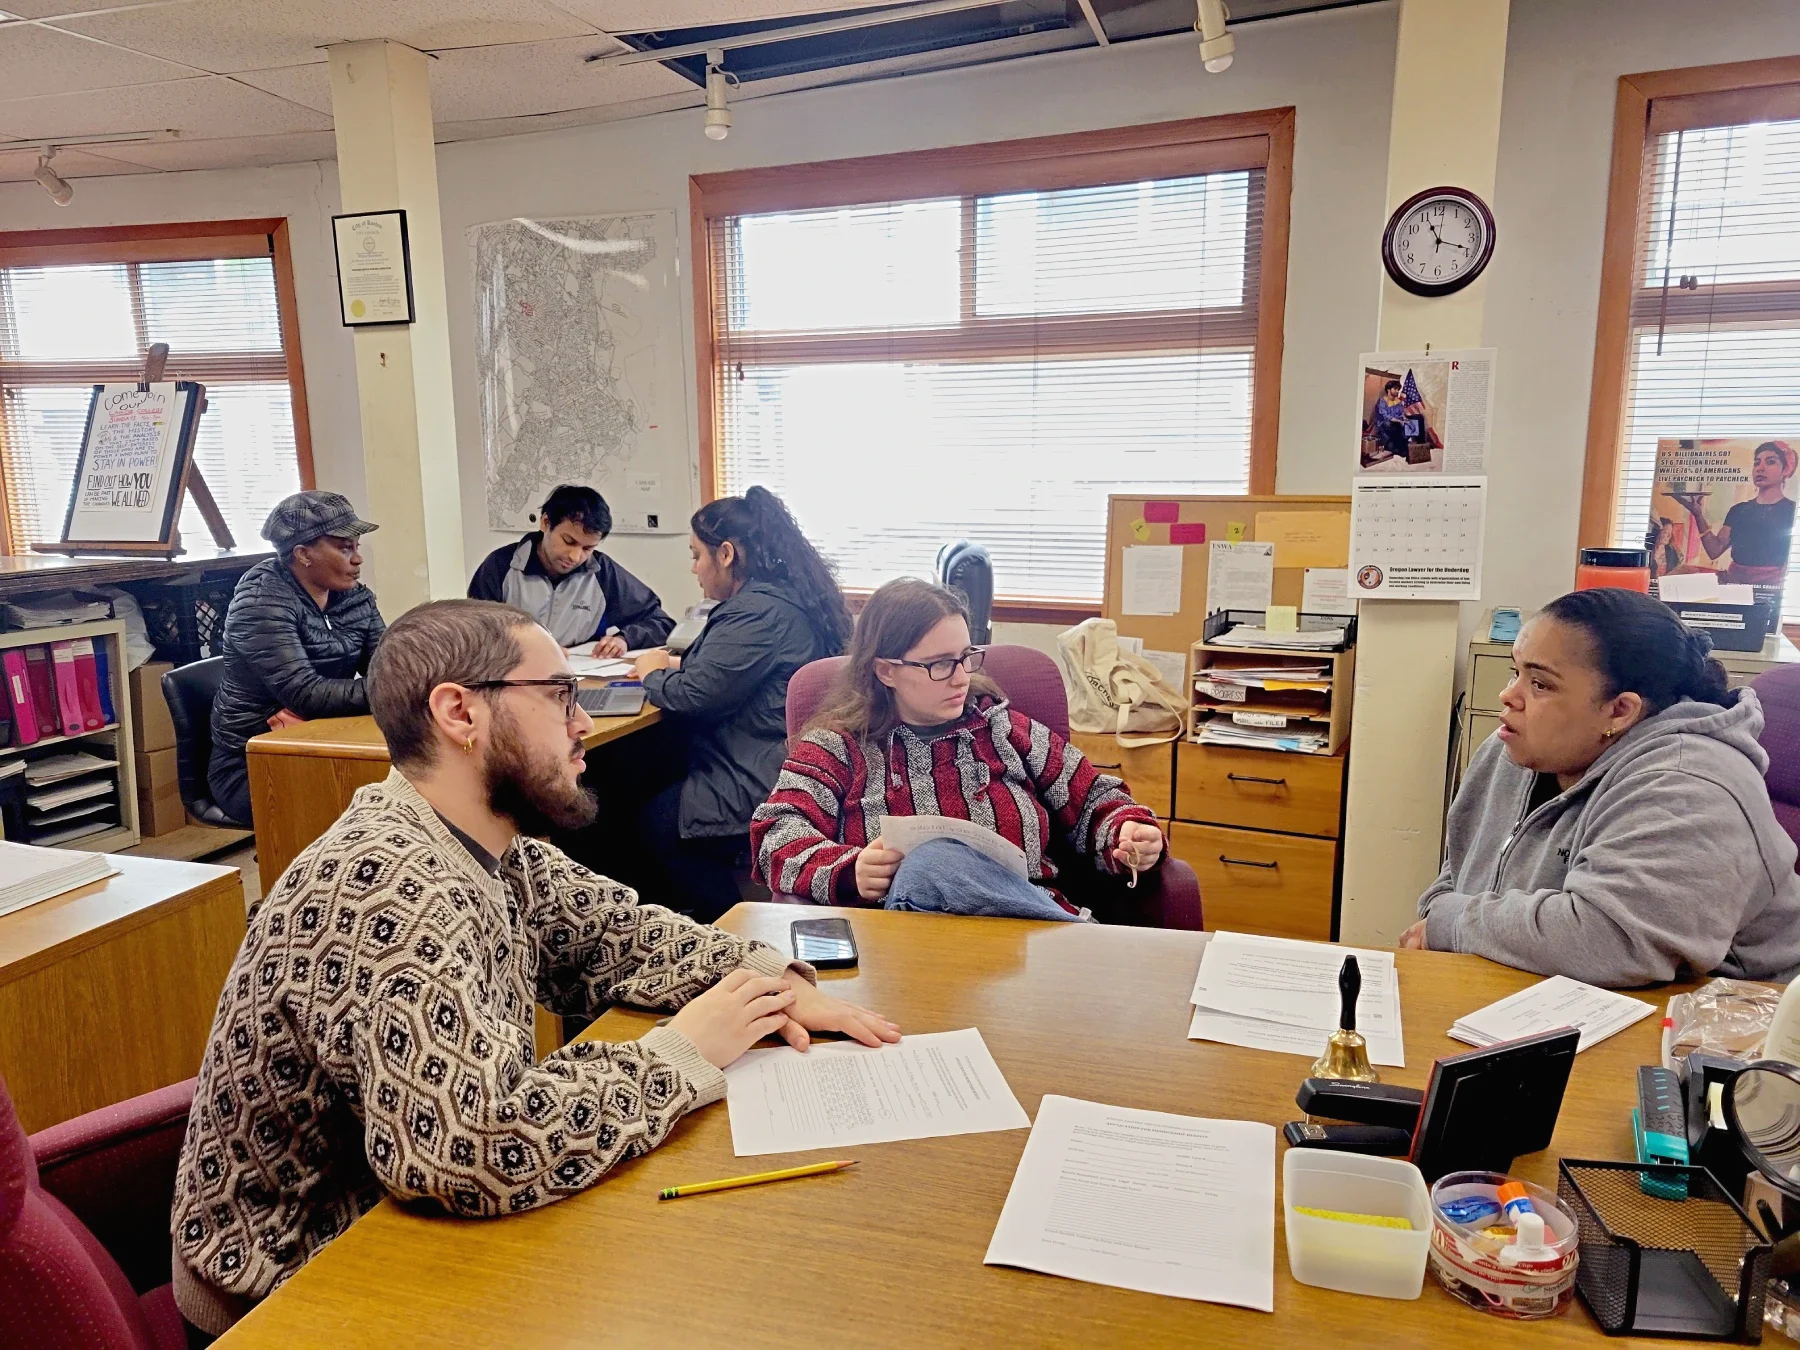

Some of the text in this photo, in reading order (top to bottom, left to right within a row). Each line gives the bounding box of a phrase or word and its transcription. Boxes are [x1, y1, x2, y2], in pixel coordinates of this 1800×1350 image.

[1434, 206, 1446, 216] 12
[1455, 209, 1458, 218] 1
[1421, 212, 1429, 222] 11
[1464, 218, 1471, 228] 2
[1409, 224, 1419, 235] 10
[1468, 233, 1475, 243] 3
[1403, 240, 1409, 250] 9
[1464, 248, 1470, 257] 4
[1407, 253, 1414, 264] 8
[1420, 263, 1426, 273] 7
[1451, 260, 1458, 270] 5
[1434, 266, 1441, 276] 6
[1452, 361, 1459, 370] R
[105, 391, 139, 410] Come
[120, 402, 142, 410] our
[93, 458, 116, 471] STAY
[117, 458, 126, 467] IN
[87, 473, 153, 490] FIND OUT HOW YOU
[112, 490, 150, 507] WE ALL NEED
[1211, 689, 1244, 700] PROGRESS
